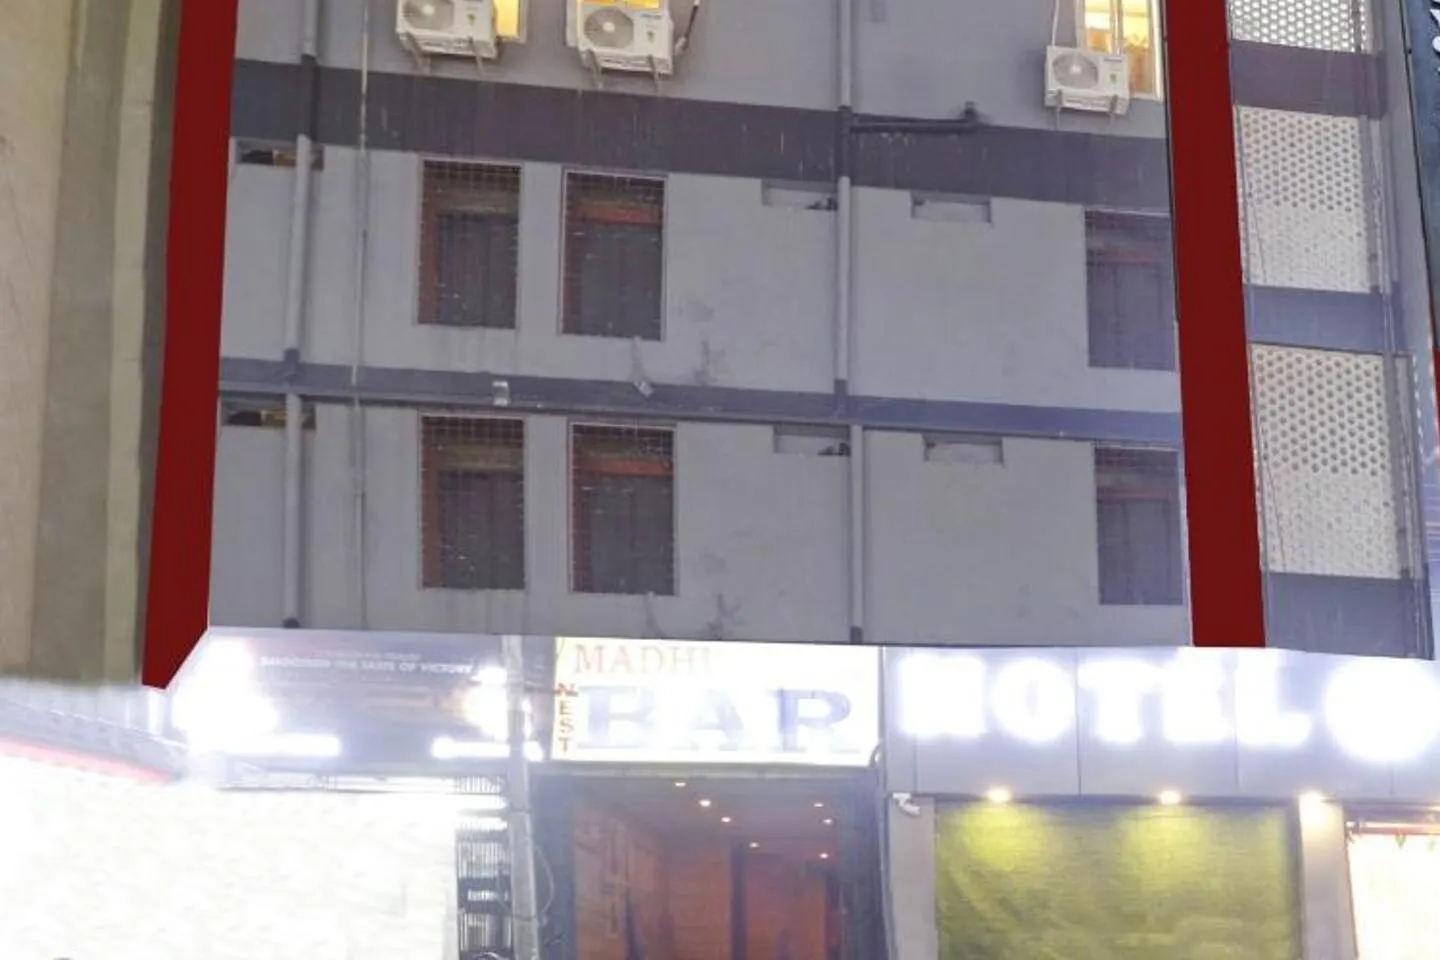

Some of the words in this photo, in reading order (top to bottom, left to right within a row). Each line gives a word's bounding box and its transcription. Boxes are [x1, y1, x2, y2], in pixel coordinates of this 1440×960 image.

[555, 682, 577, 753] NEST
[577, 685, 861, 756] BAR
[898, 649, 1312, 746] HOTEL
